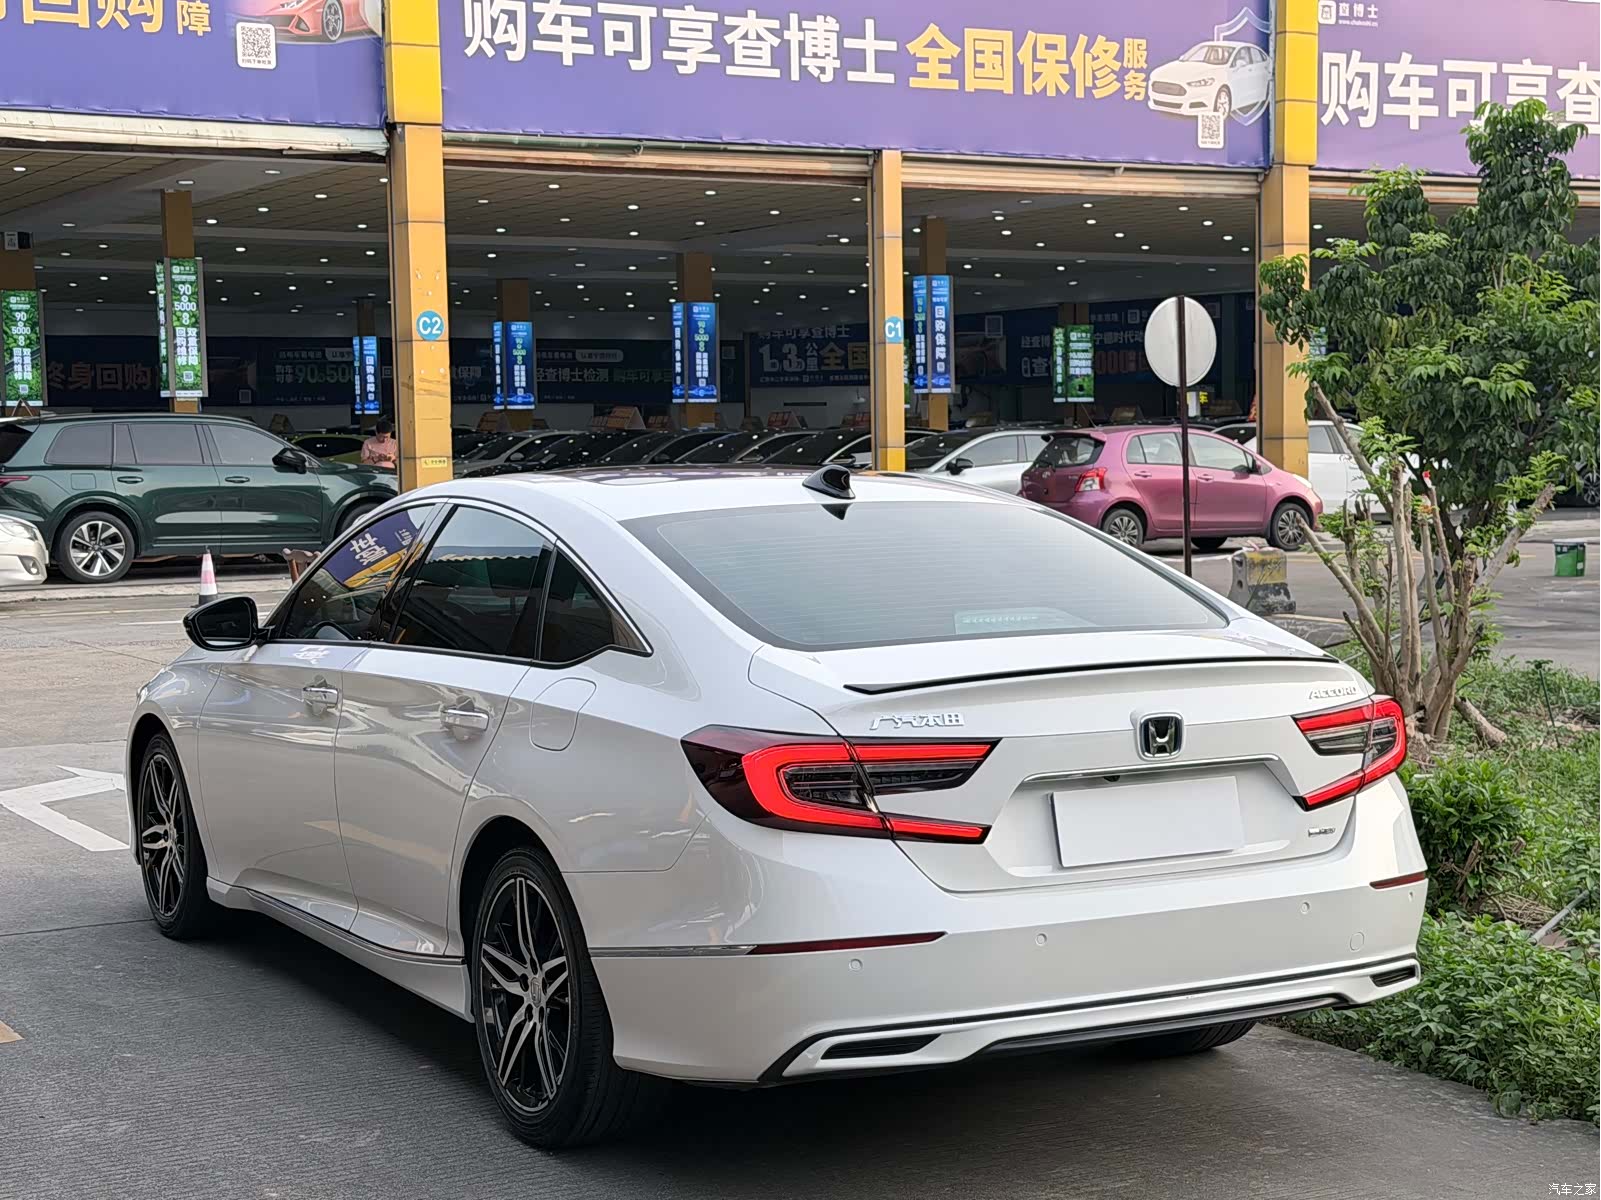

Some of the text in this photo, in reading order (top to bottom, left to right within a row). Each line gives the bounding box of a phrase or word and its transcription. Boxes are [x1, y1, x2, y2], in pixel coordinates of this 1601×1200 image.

[419, 316, 442, 335] C2
[885, 321, 902, 338] C1
[1309, 686, 1358, 700] ACCORD
[869, 712, 965, 731] 广汽本田
